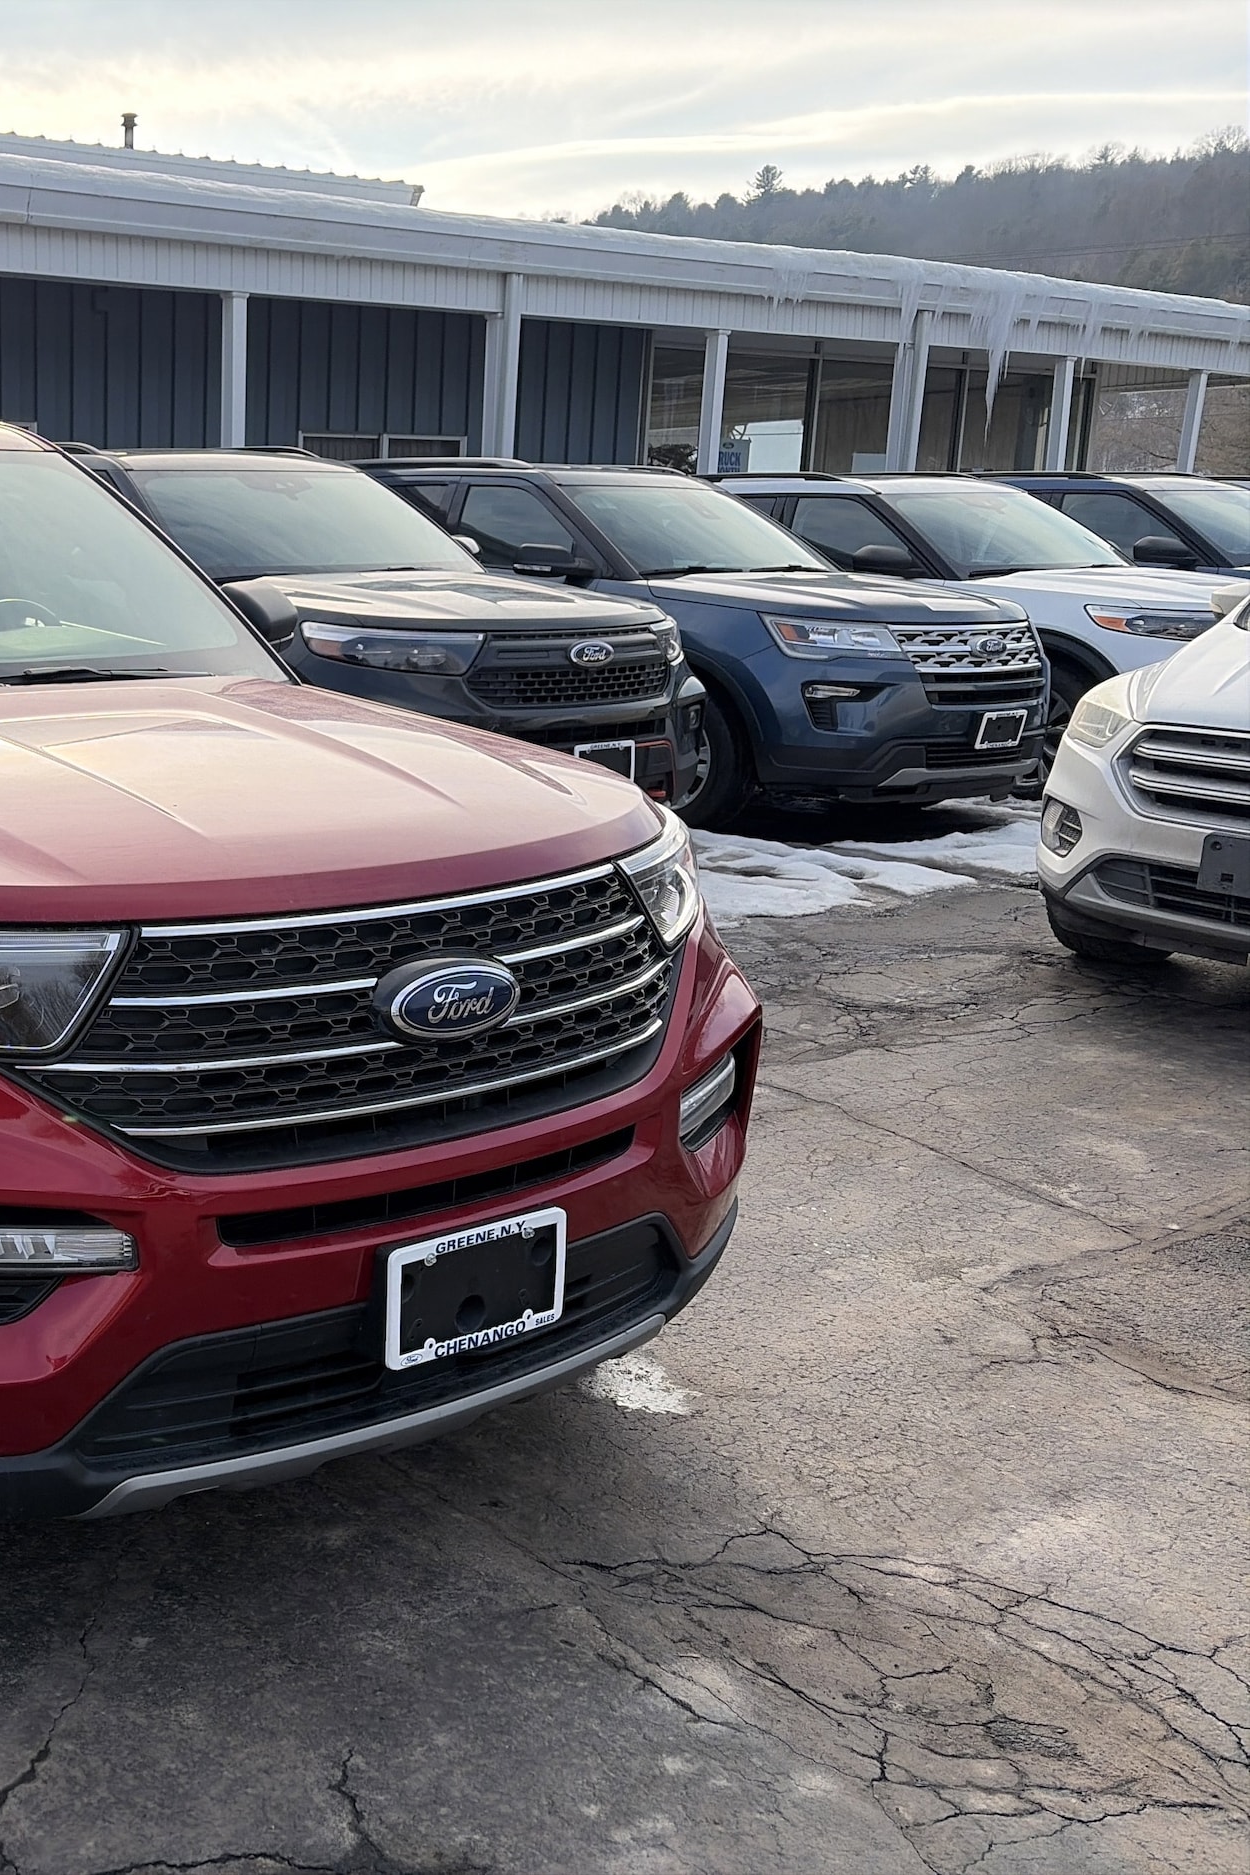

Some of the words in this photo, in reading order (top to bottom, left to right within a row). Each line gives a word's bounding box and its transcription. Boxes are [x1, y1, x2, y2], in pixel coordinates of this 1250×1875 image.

[718, 451, 741, 466] RUCK
[582, 646, 606, 661] Ford
[427, 980, 495, 1024] Ford
[434, 1320, 526, 1358] CHENANGO
[535, 1313, 555, 1326] SALES
